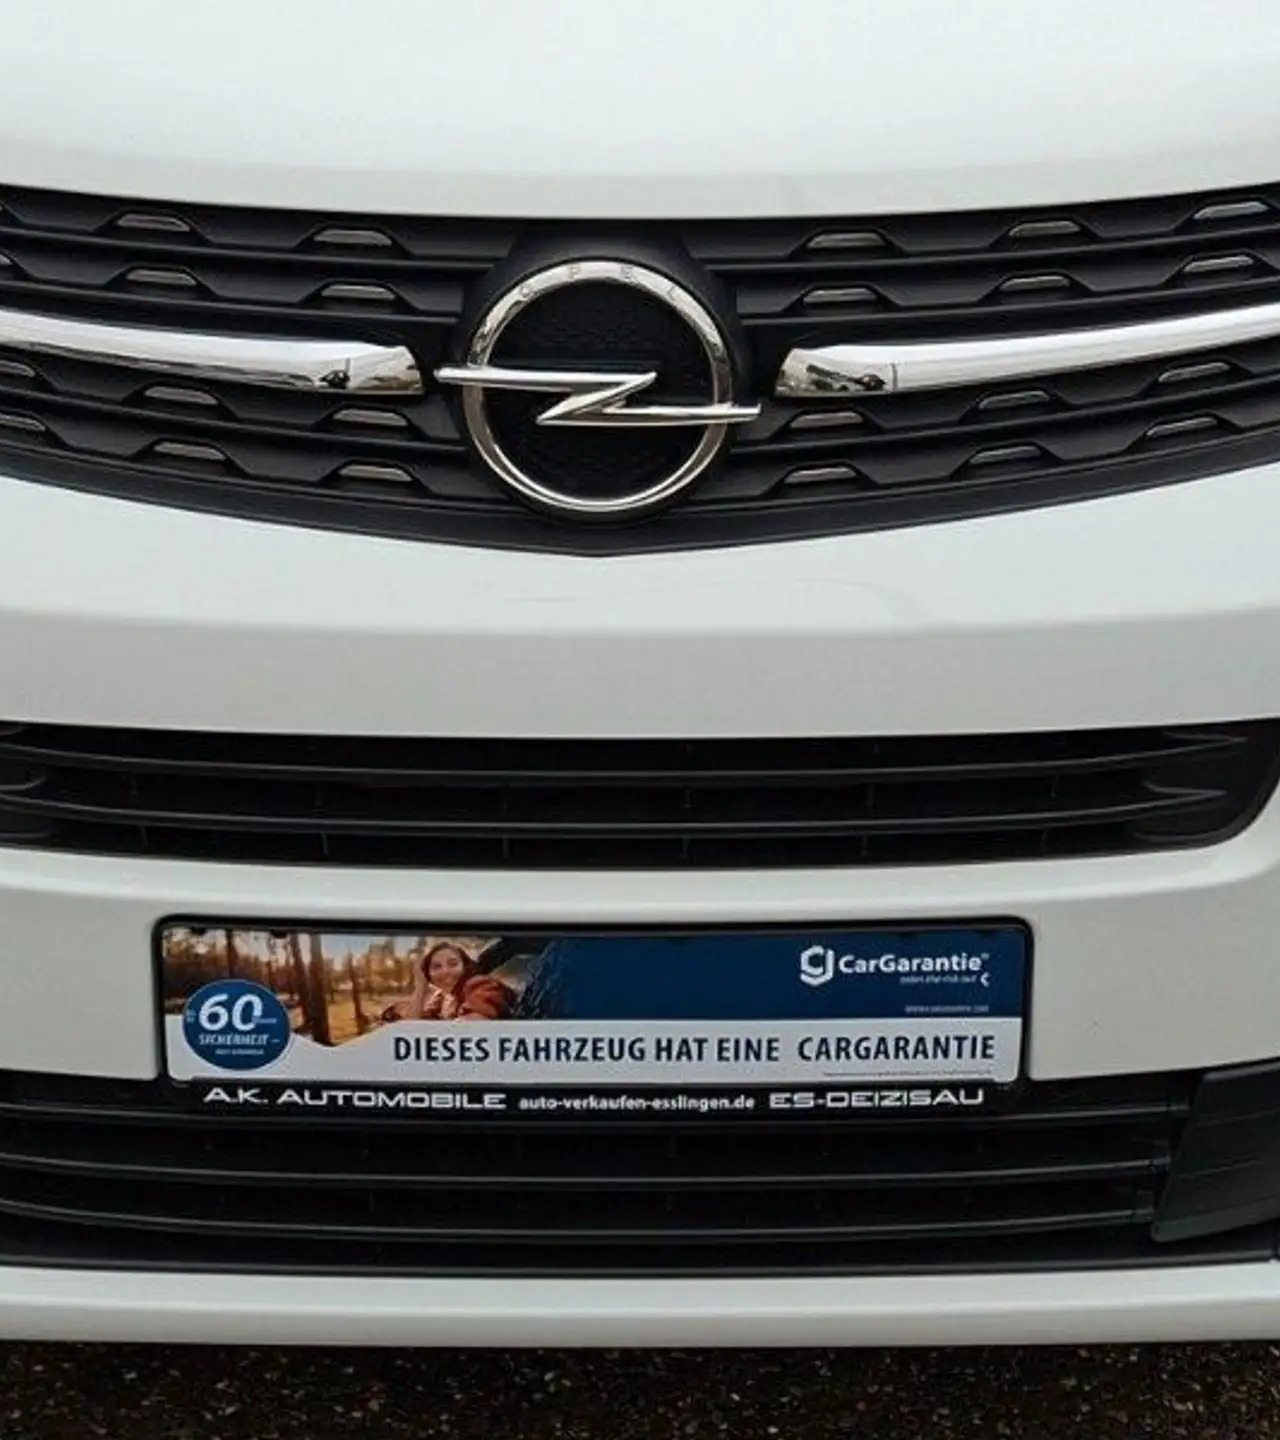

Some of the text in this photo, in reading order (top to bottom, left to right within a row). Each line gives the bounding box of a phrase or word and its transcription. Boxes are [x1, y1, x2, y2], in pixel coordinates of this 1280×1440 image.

[838, 953, 982, 973] CarGarantie
[198, 993, 263, 1031] 60
[393, 1035, 996, 1061] DIESES FAHRZEUG HAT EINE CARGARANTIE
[203, 1087, 984, 1113] A.K. AUTOMOBILE auto-verkaufen-esslingen.de ES-DEIZISAU
